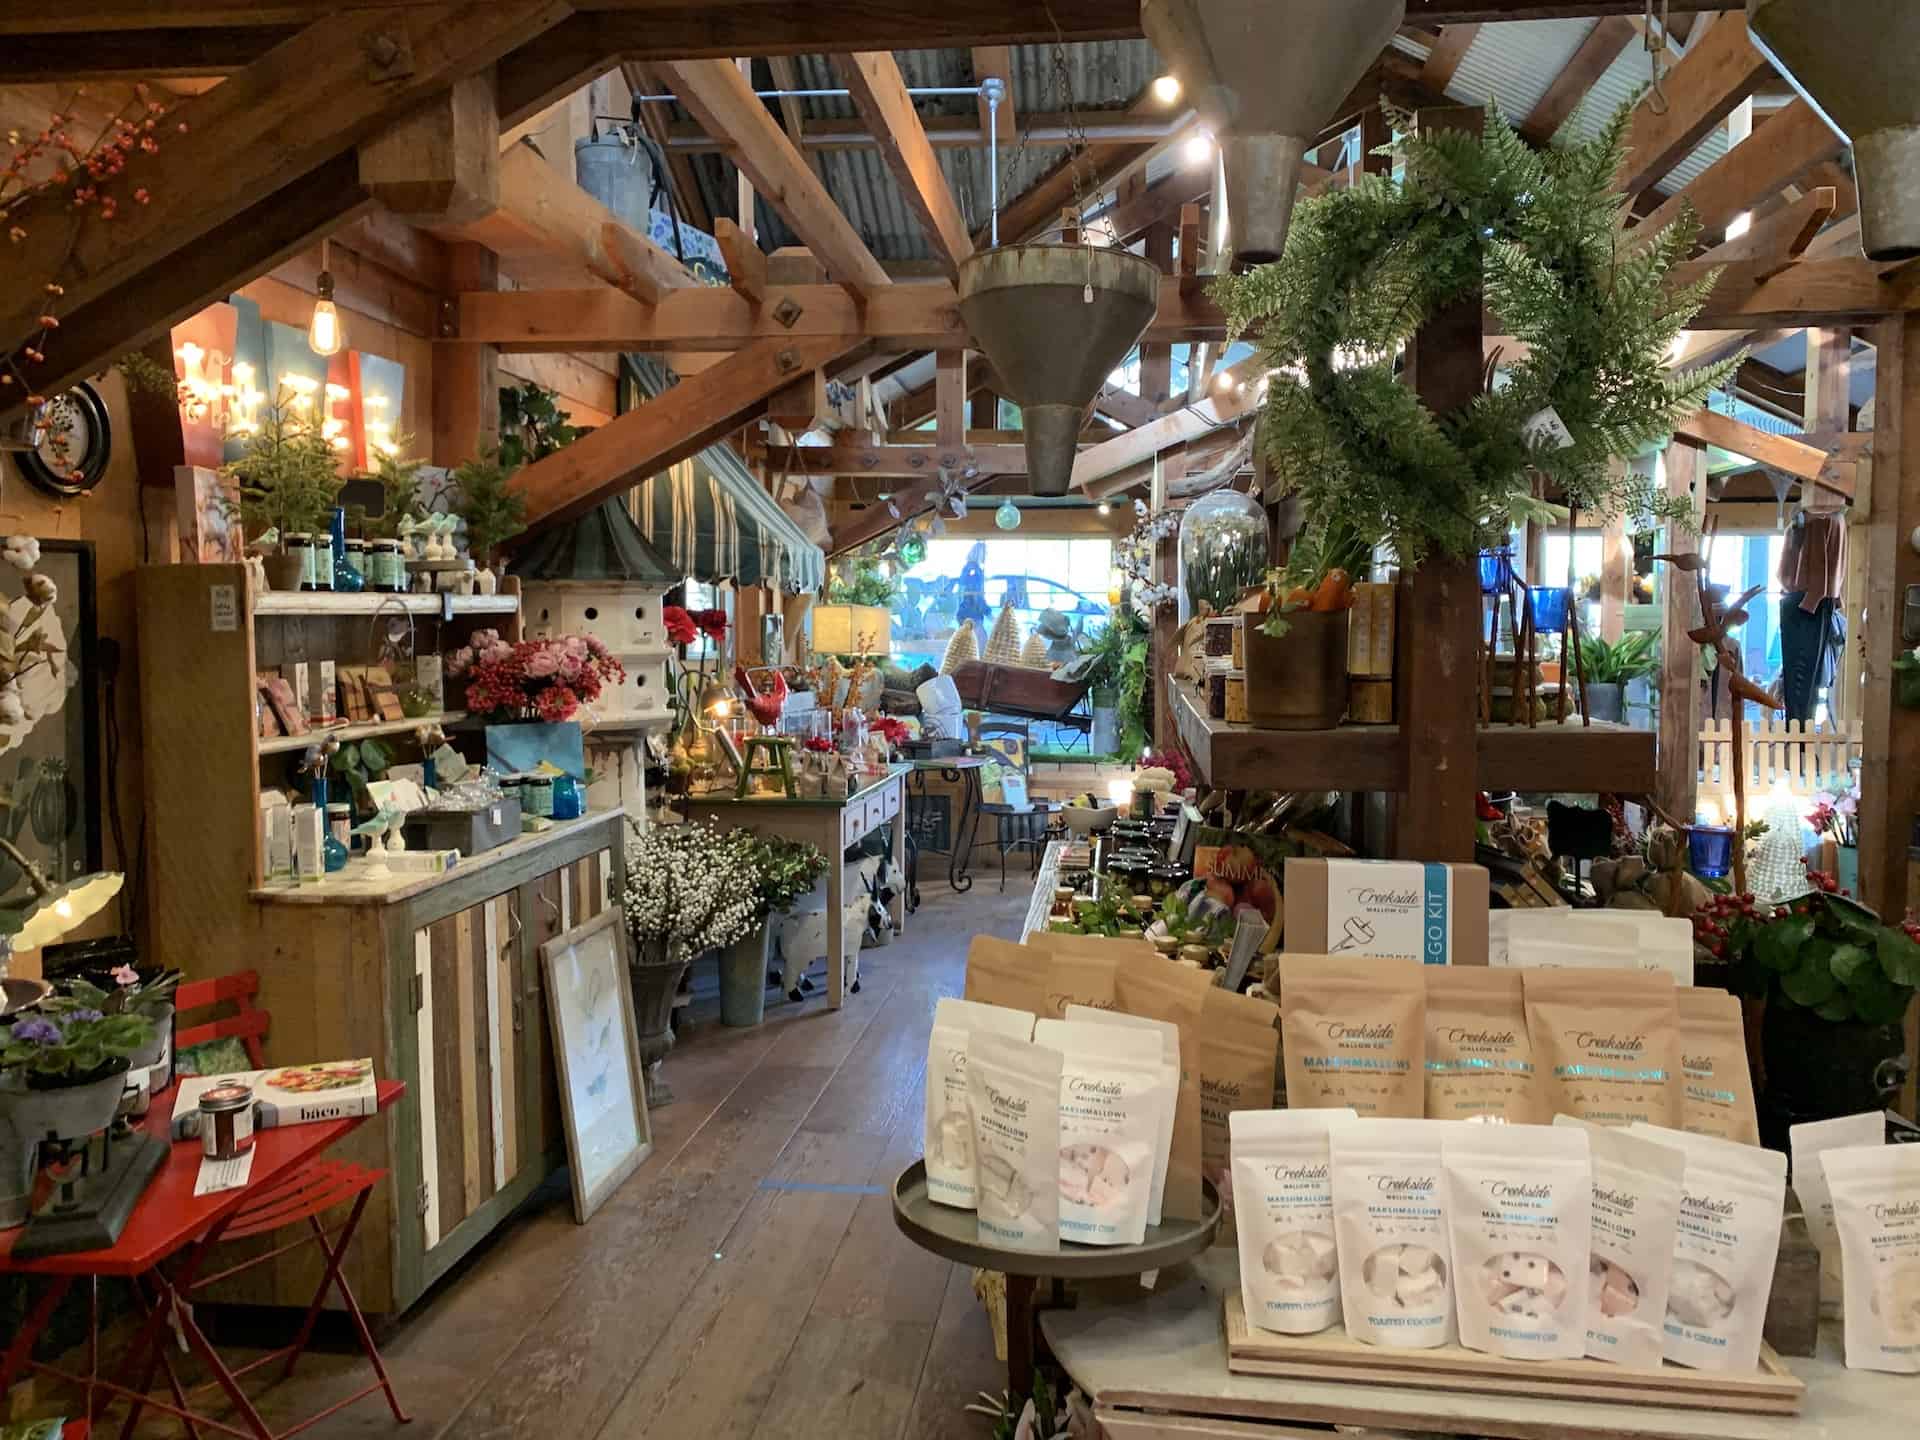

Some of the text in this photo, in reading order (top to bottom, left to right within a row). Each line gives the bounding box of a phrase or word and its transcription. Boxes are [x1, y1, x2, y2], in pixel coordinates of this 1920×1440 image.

[1347, 888, 1420, 908] Creekside
[1428, 890, 1442, 919] KIT
[1316, 1022, 1395, 1041] Creekside
[1437, 1027, 1516, 1043] Creekside
[1564, 1031, 1646, 1050] Creekside
[1068, 1077, 1126, 1097] Creekside
[1265, 1164, 1328, 1180] Creekside
[1367, 1176, 1434, 1192] Creekside
[1481, 1179, 1552, 1199] Creekside
[1500, 1199, 1530, 1208] MALLOW
